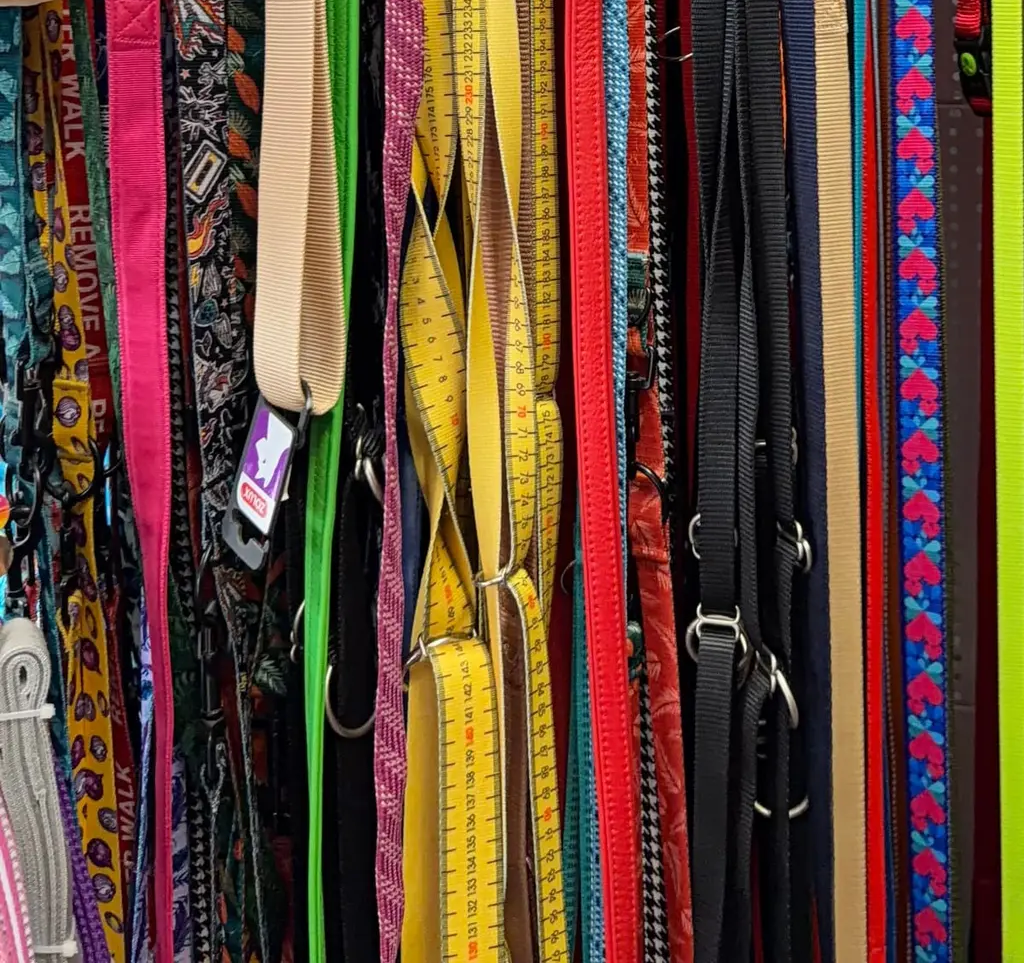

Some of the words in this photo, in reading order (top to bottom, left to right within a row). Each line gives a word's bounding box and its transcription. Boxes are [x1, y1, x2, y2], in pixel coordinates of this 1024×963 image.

[463, 20, 473, 40] 233
[463, 42, 474, 62] 232
[539, 38, 547, 56] 194
[463, 64, 474, 84] 231
[539, 60, 547, 77] 193
[424, 86, 434, 103] 175
[464, 84, 473, 105] 230
[427, 105, 436, 125] 174
[465, 106, 473, 126] 229
[540, 143, 549, 162] 189
[541, 187, 551, 205] 187
[541, 207, 551, 226] 186
[541, 228, 551, 247] 185
[542, 270, 551, 289] 183
[542, 292, 551, 310] 182
[542, 313, 551, 332] 181
[422, 317, 432, 325] 5
[427, 336, 437, 344] 6
[438, 374, 448, 383] 8
[444, 395, 454, 403] 9
[515, 361, 525, 375] 68
[516, 382, 526, 397] 69
[517, 405, 527, 419] 70
[517, 427, 528, 439] 71
[518, 449, 529, 463] 72
[519, 471, 530, 485] 73
[465, 749, 475, 768] 139
[465, 770, 476, 791] 138
[465, 793, 476, 812] 137
[466, 812, 477, 834] 136
[466, 834, 477, 855] 135
[466, 856, 477, 876] 134
[467, 878, 477, 898] 133
[467, 900, 478, 919] 132
[467, 921, 478, 940] 131
